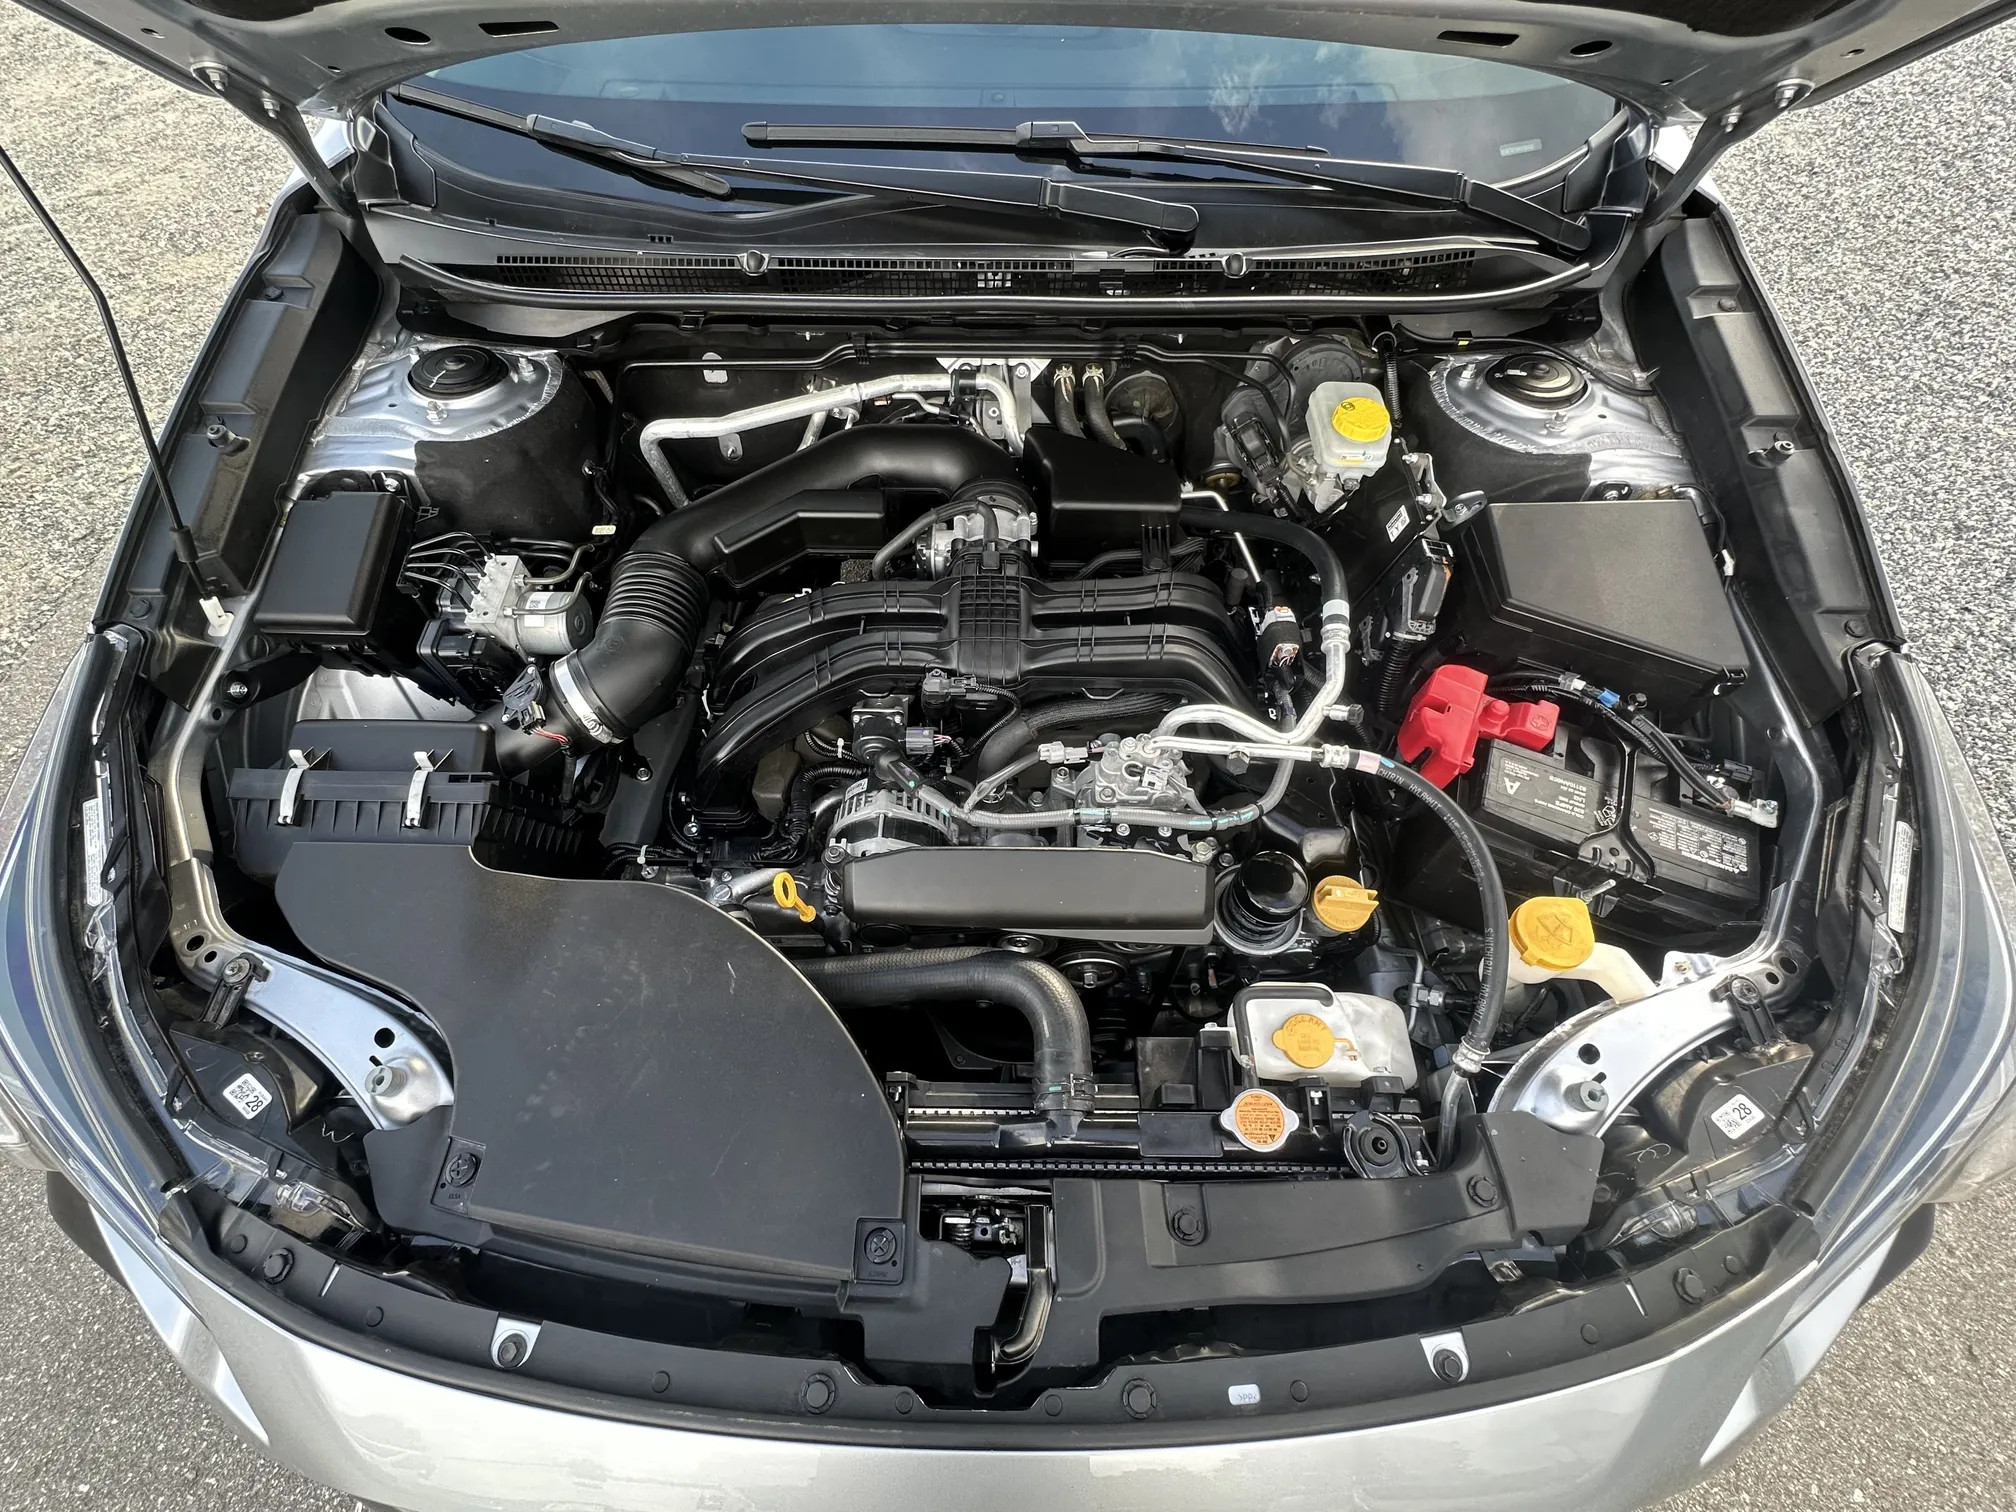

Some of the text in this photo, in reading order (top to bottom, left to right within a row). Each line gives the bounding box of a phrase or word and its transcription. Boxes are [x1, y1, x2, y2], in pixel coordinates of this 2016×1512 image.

[1377, 767, 1405, 786] CHIRIN
[1503, 776, 1521, 795] A
[245, 1095, 265, 1113] 28
[1732, 1103, 1752, 1120] 28
